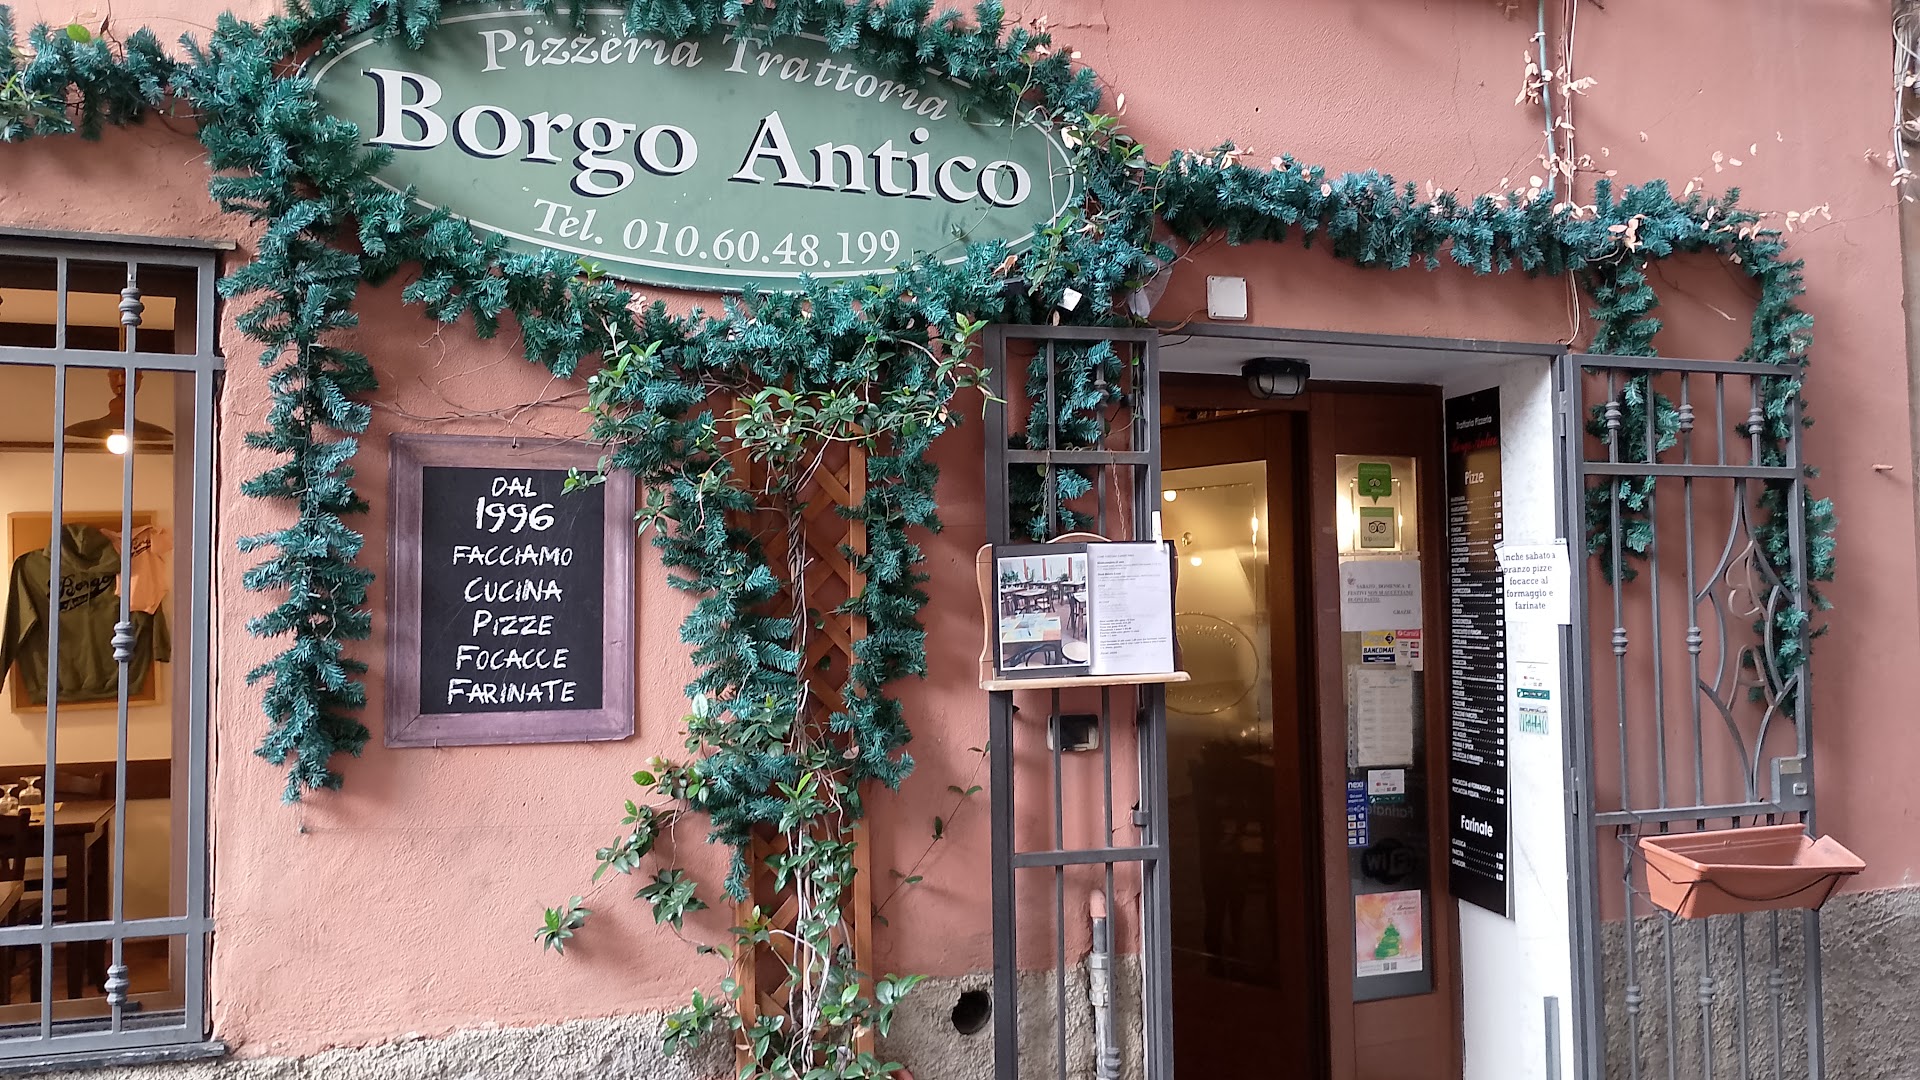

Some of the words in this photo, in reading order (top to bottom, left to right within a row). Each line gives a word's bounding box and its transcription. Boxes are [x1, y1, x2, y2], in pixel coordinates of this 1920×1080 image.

[479, 26, 703, 73] Pizzeria
[722, 33, 948, 122] Trattoria
[361, 67, 699, 198] Borgo
[728, 110, 1031, 208] Antico
[534, 198, 604, 246] Tel.
[623, 218, 902, 268] 010.60.48.199
[491, 476, 538, 498] DAL
[1464, 470, 1484, 486] Pizze
[475, 497, 555, 533] 1996
[452, 544, 573, 567] FACCIAMO
[1503, 552, 1523, 561] nche
[1526, 552, 1550, 561] sabato
[1504, 566, 1530, 575] pranzo
[1532, 566, 1552, 574] pizze
[1510, 577, 1539, 585] focacce
[1541, 576, 1549, 584] al
[464, 577, 562, 602] CUCINA
[1506, 589, 1547, 599] formaggio
[1515, 601, 1546, 610] farinate
[472, 609, 554, 637] PIZZE
[455, 644, 570, 671] FOCACCE
[447, 678, 578, 705] FARINATE
[1461, 815, 1494, 838] Farinate
